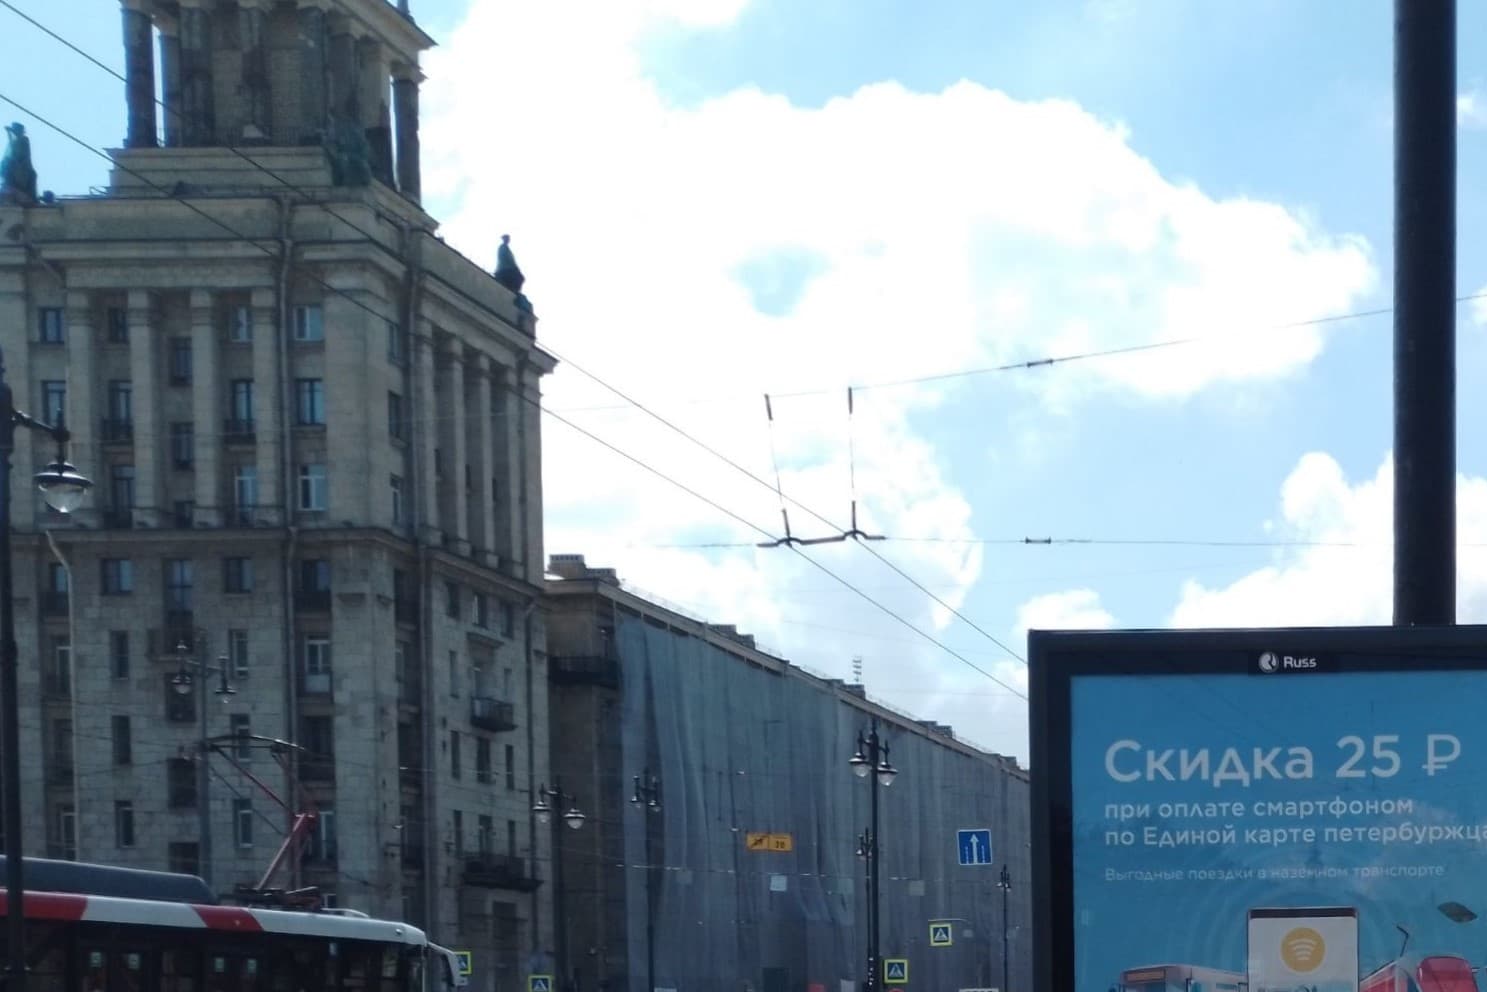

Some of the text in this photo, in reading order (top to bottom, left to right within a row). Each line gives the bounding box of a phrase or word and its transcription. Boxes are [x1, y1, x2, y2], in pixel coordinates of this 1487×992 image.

[1283, 656, 1317, 668] Russ
[1104, 739, 1313, 787] Скидка
[1336, 735, 1400, 778] 25
[1105, 795, 1413, 821] при оплате смартфоном
[1105, 830, 1135, 846] по
[1144, 823, 1236, 848] Единой
[1245, 826, 1316, 845] карте
[1105, 868, 1183, 882] Выгодные
[1188, 868, 1251, 881] поездки
